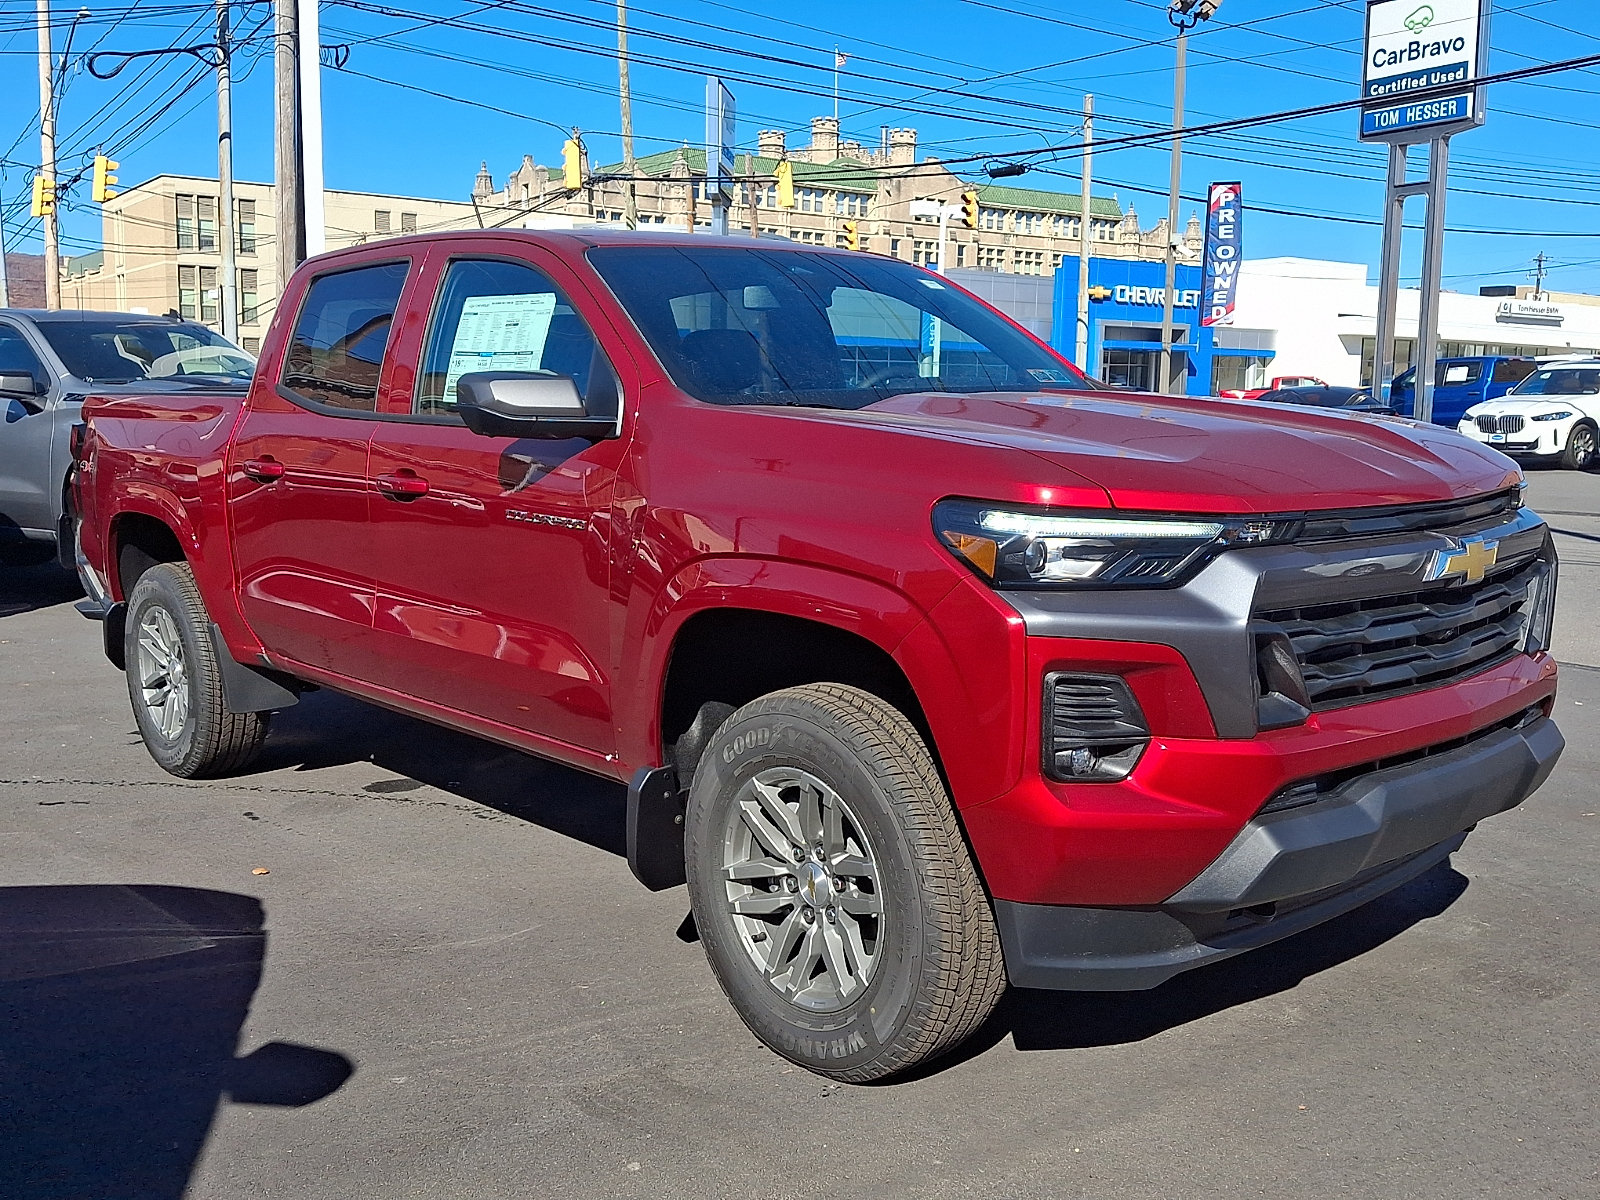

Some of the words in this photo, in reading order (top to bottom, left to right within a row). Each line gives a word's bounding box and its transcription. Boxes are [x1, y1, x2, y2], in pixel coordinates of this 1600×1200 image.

[1372, 36, 1465, 68] CarBravo
[1370, 74, 1427, 96] Certified
[1431, 67, 1464, 84] Used
[1374, 110, 1400, 128] TOM
[1406, 100, 1457, 123] HESSER
[1218, 192, 1236, 239] PRE
[1114, 284, 1201, 307] CHEVRLET
[1211, 245, 1237, 320] OWNED
